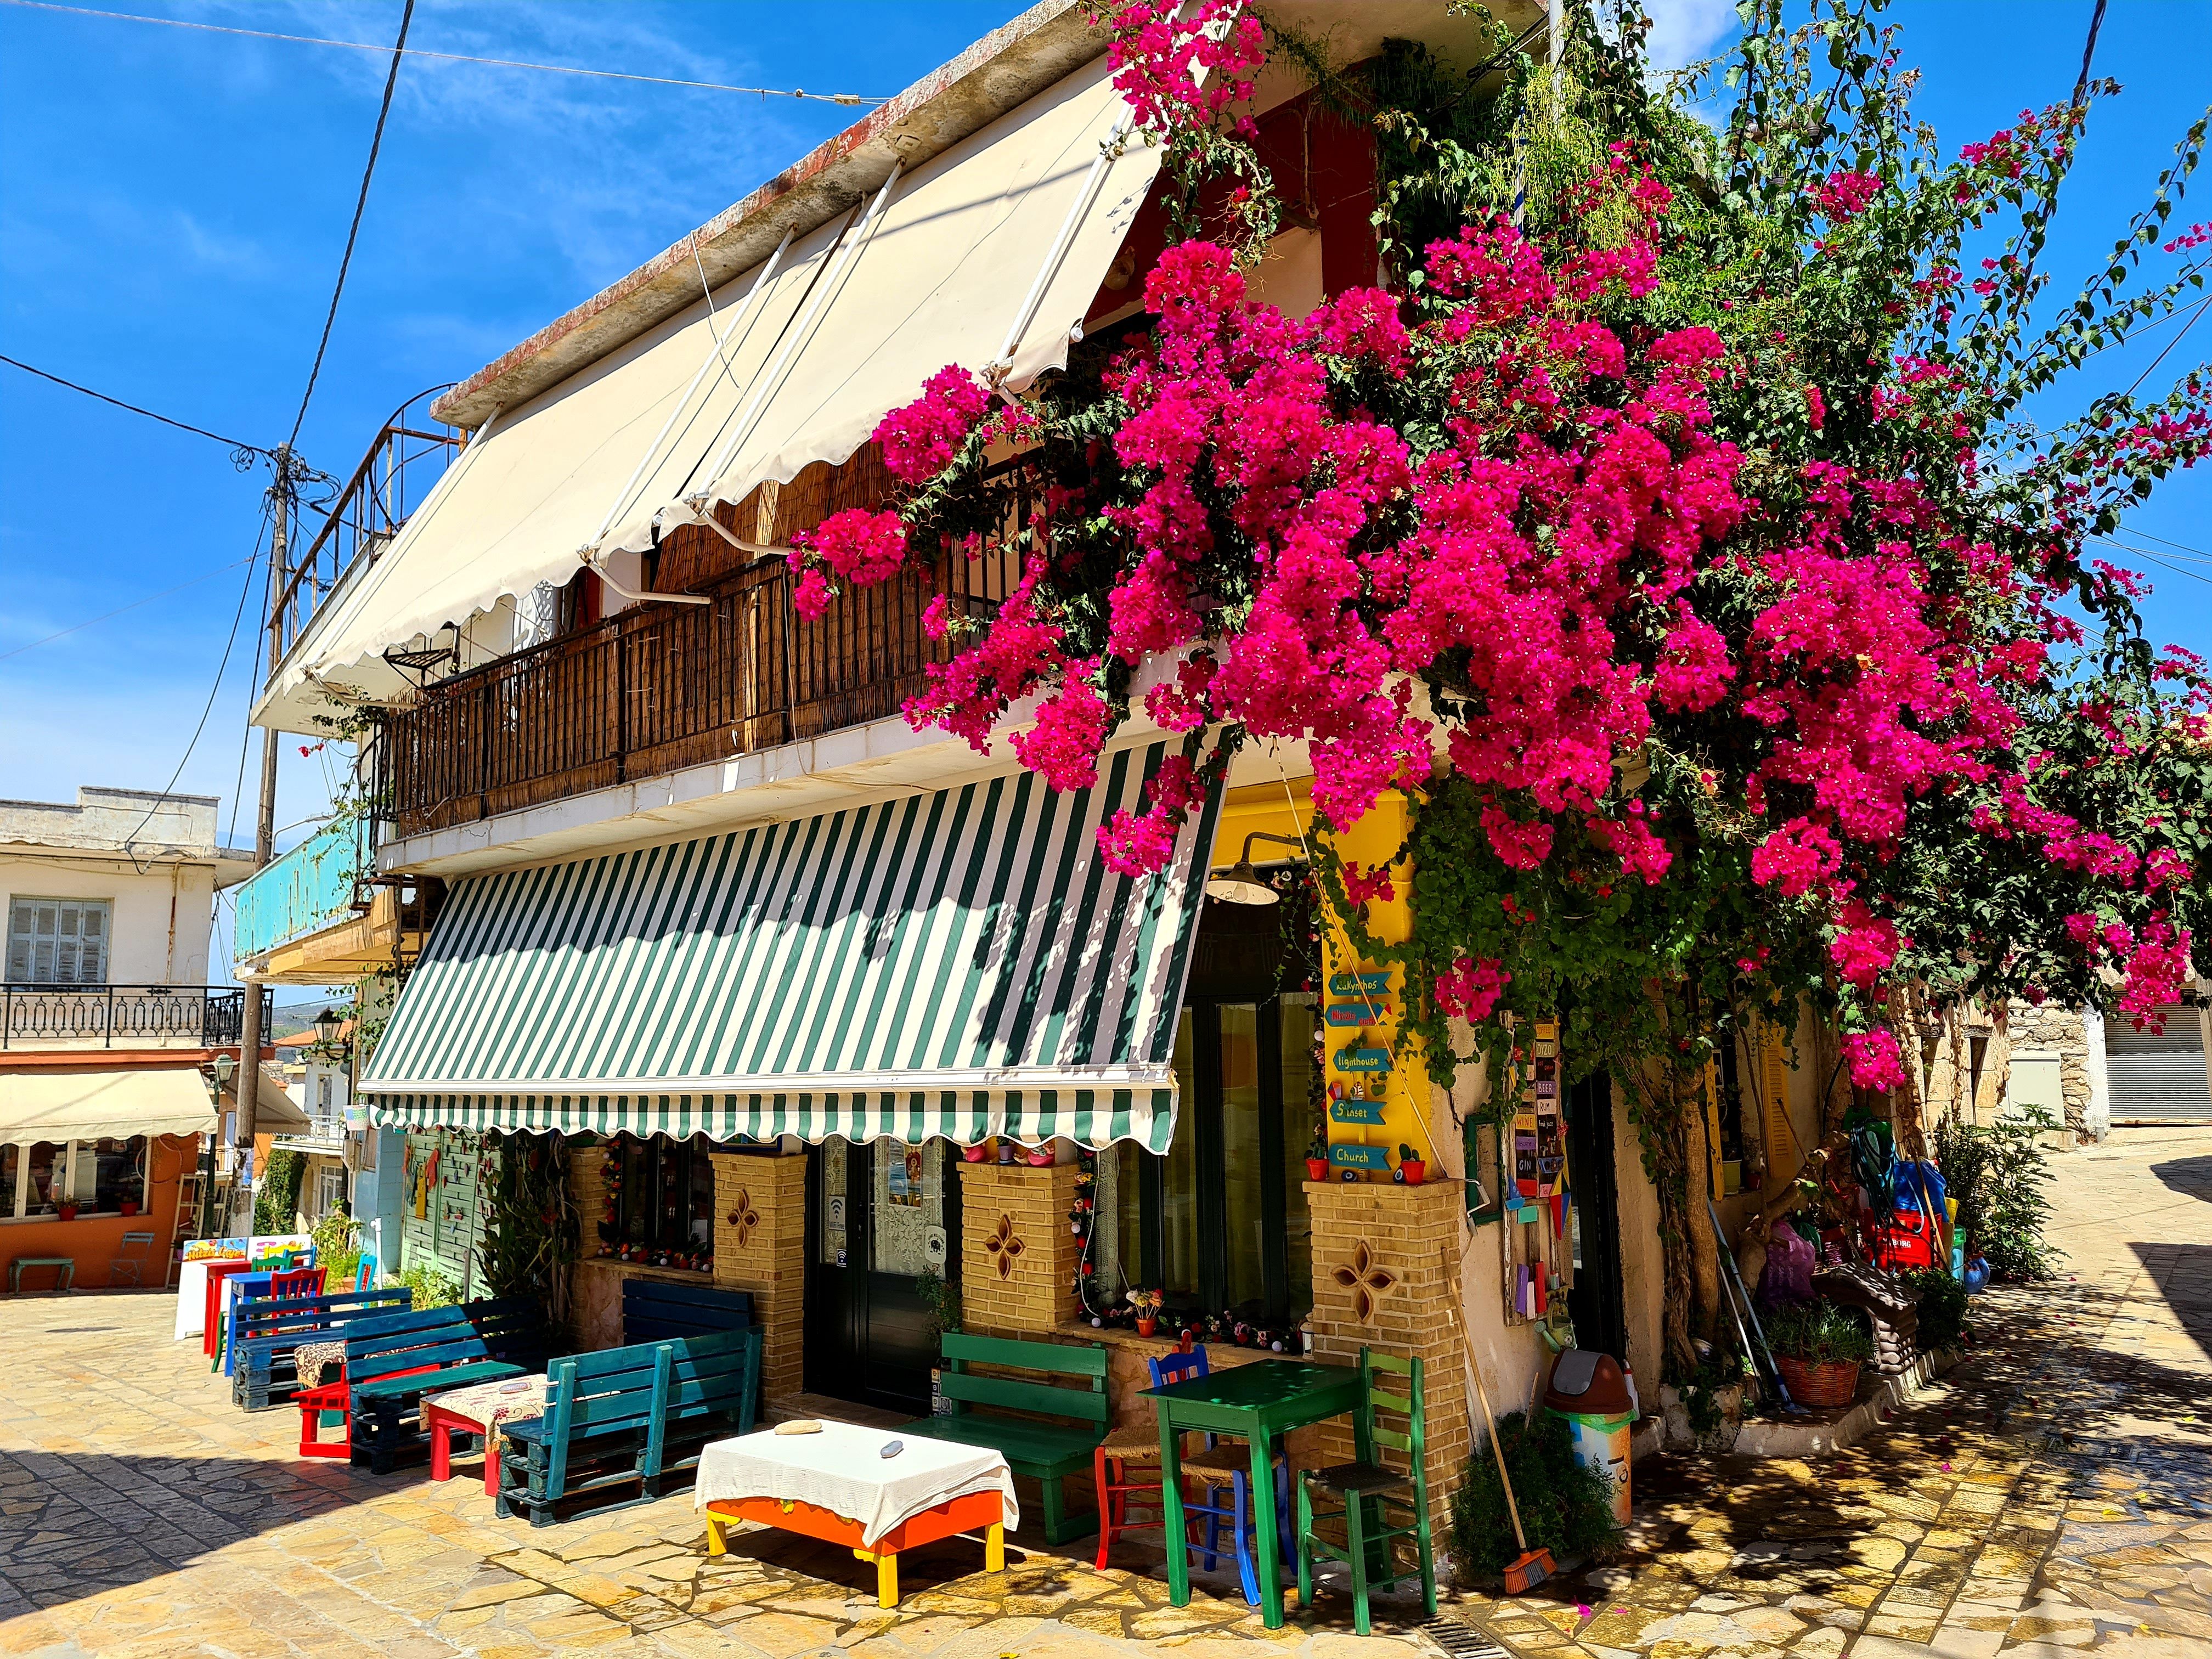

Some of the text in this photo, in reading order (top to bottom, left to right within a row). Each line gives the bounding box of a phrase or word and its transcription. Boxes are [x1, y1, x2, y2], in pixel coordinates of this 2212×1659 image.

[1336, 979, 1378, 994] akynhos
[1537, 1043, 1552, 1056] OYZO
[1538, 1083, 1553, 1093] BEER
[1540, 1102, 1550, 1111] RUM
[1516, 1117, 1532, 1127] WINE
[1336, 1148, 1369, 1163] Church
[1519, 1159, 1531, 1171] GIN
